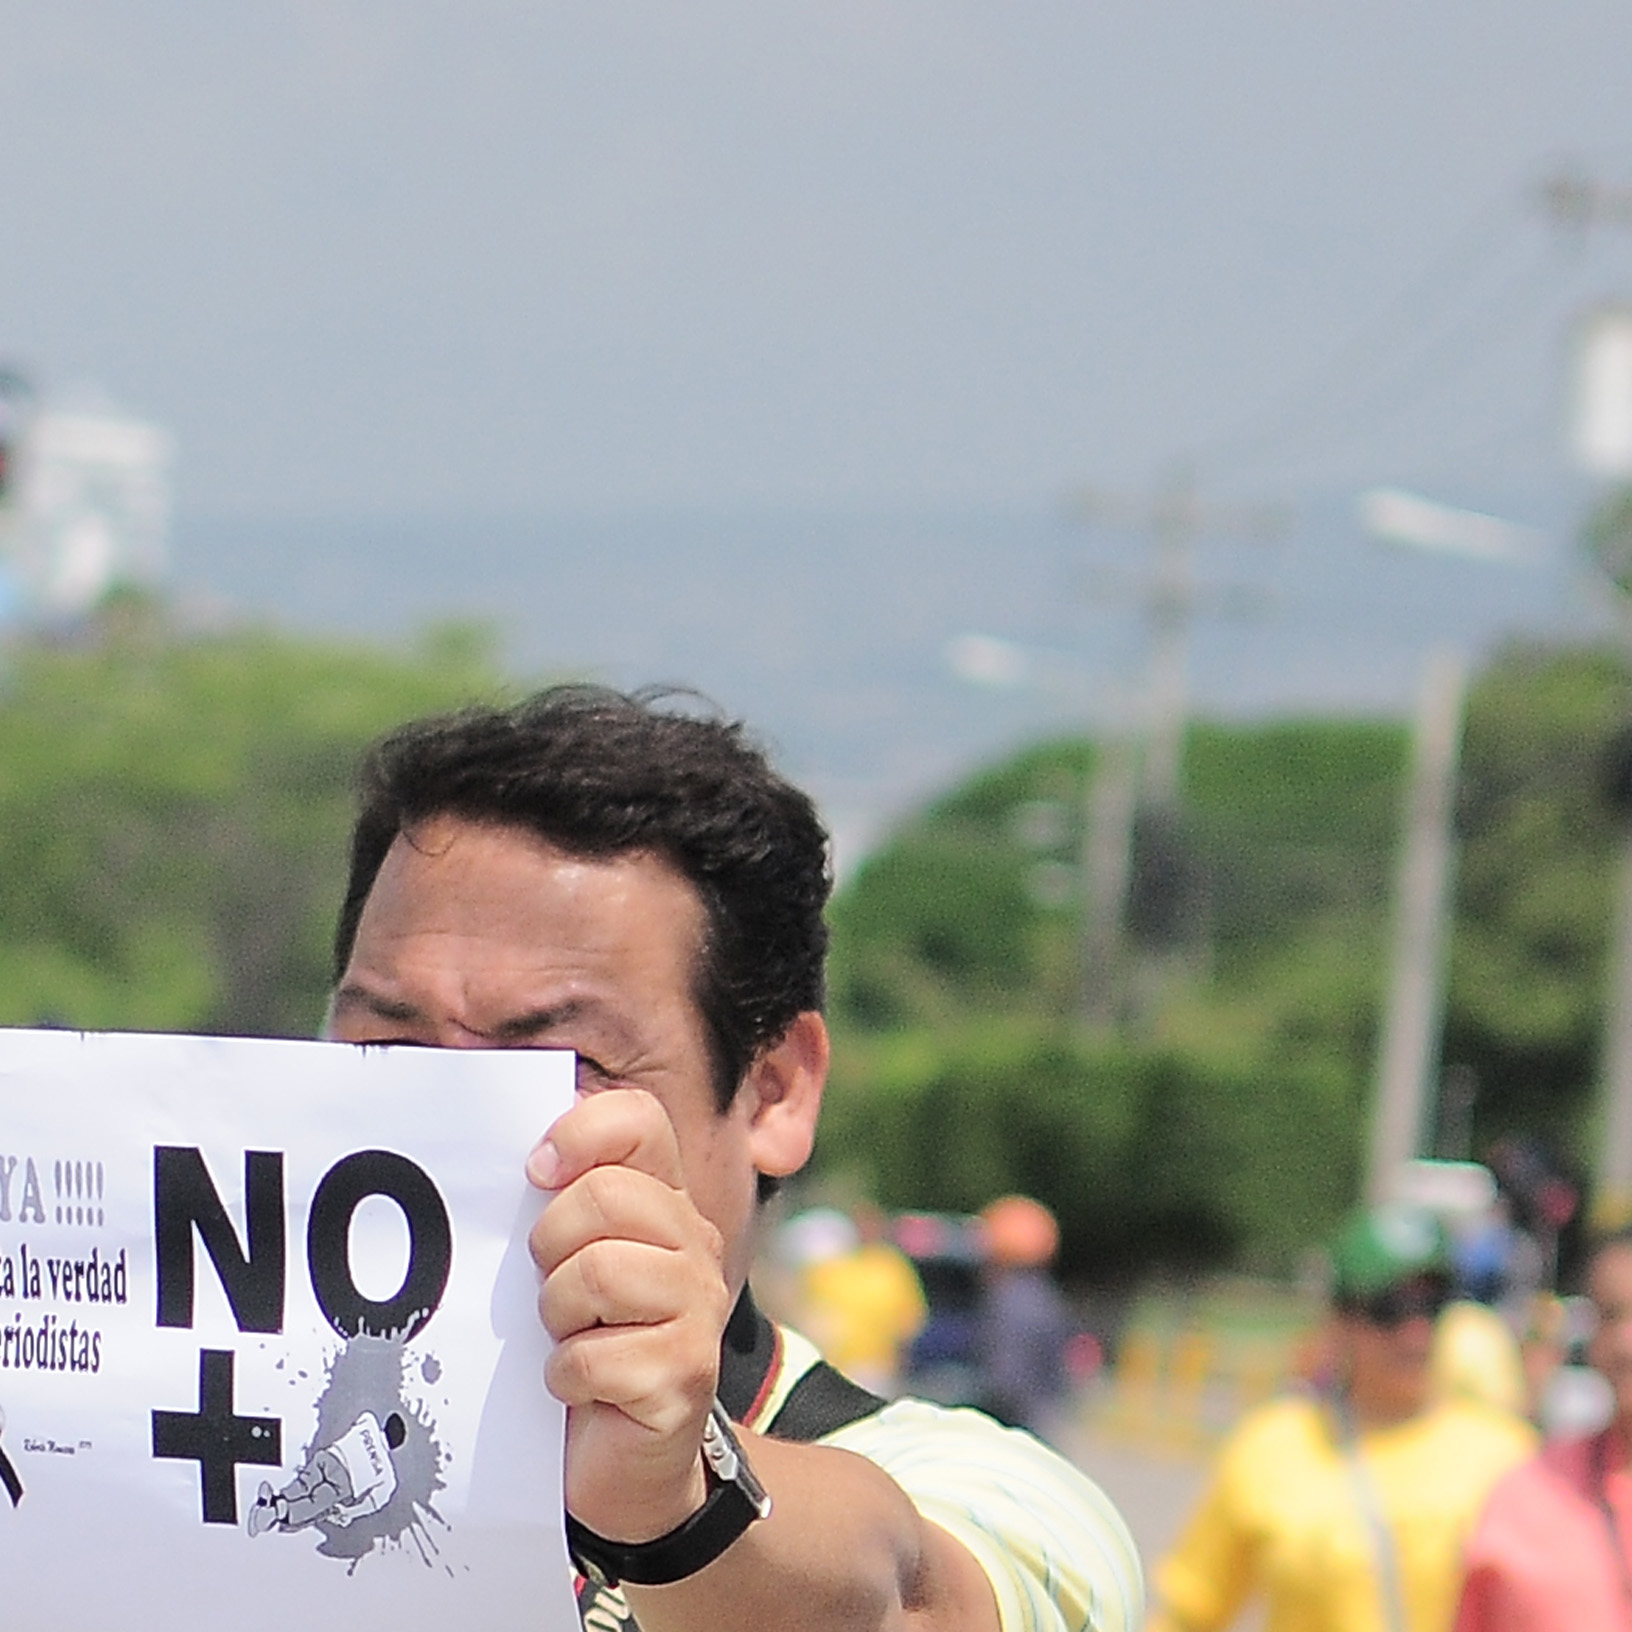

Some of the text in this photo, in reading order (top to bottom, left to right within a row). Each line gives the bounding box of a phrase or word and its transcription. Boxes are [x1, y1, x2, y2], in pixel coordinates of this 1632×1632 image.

[20, 1243, 42, 1300] la
[47, 1246, 128, 1304] verdad
[153, 1144, 453, 1344] NO
